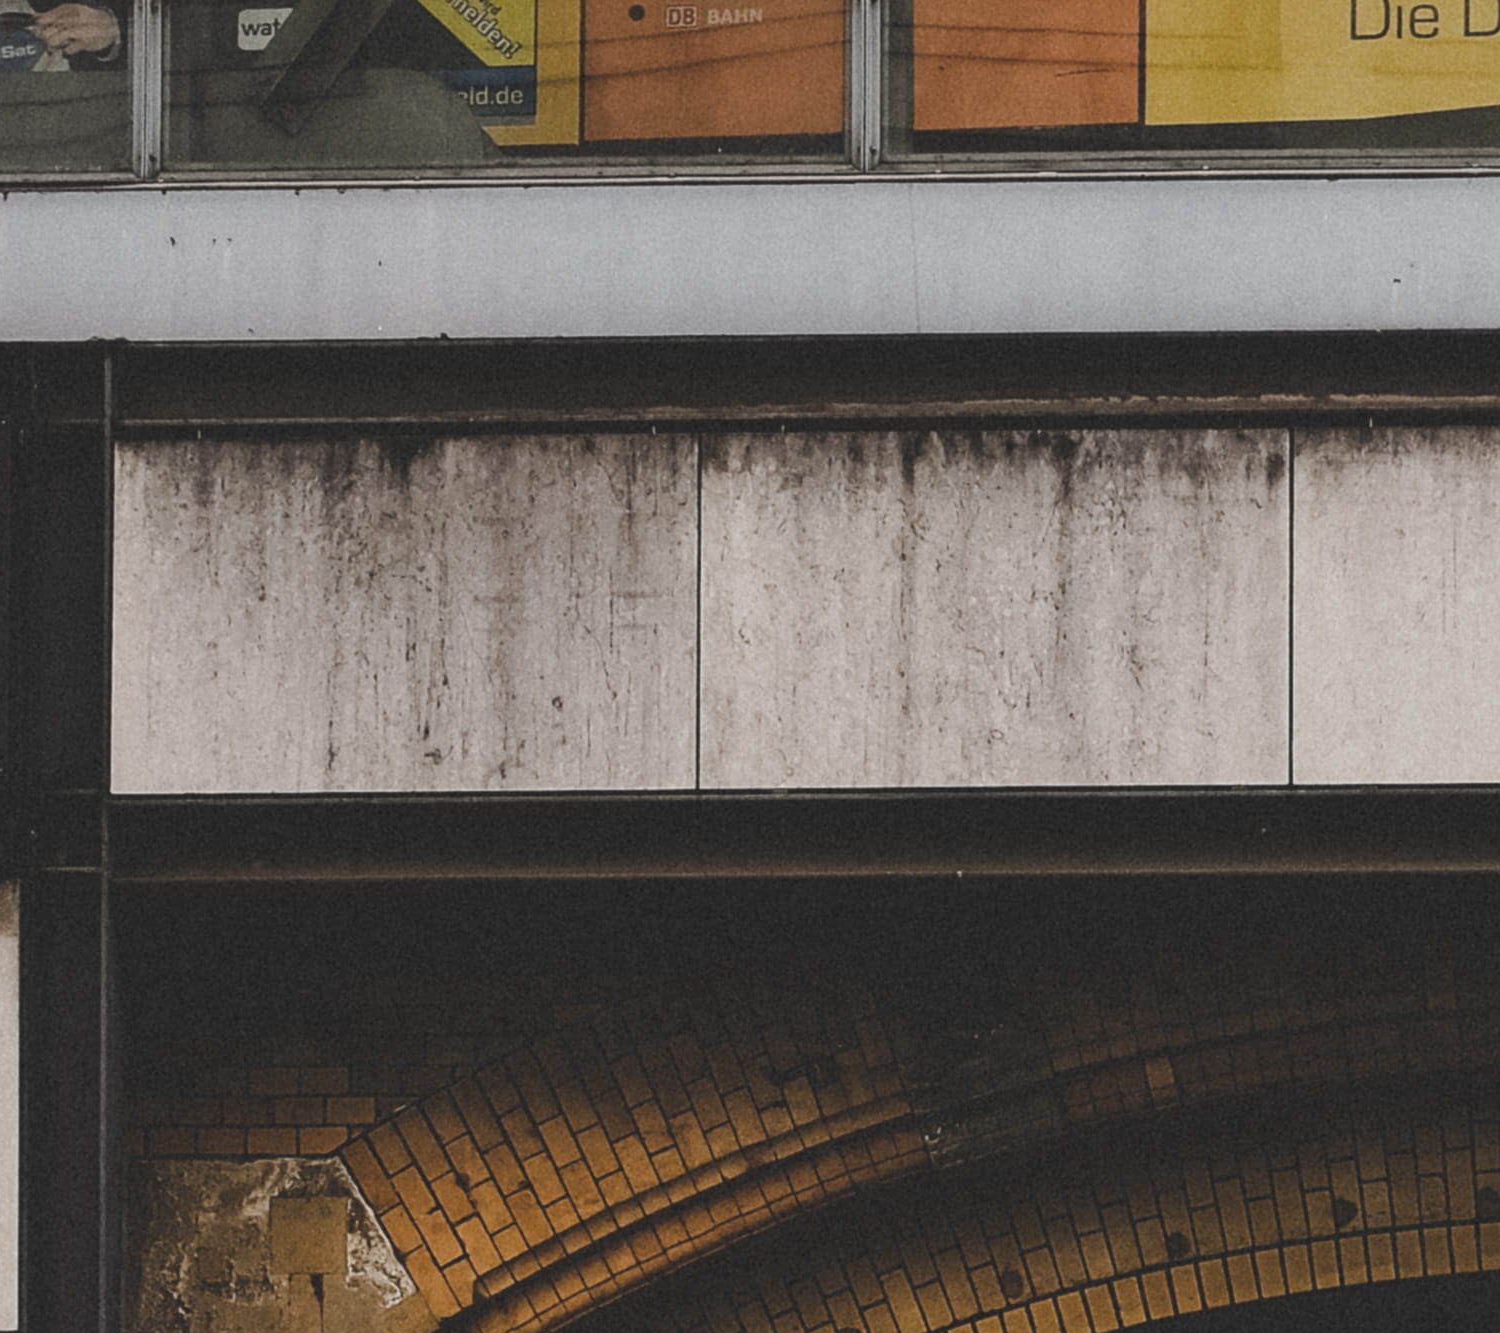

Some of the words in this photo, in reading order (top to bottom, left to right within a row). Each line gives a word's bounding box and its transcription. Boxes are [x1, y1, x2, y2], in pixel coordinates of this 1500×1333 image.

[666, 6, 697, 27] DB
[706, 8, 763, 24] BAHN
[1350, 0, 1440, 40] Die
